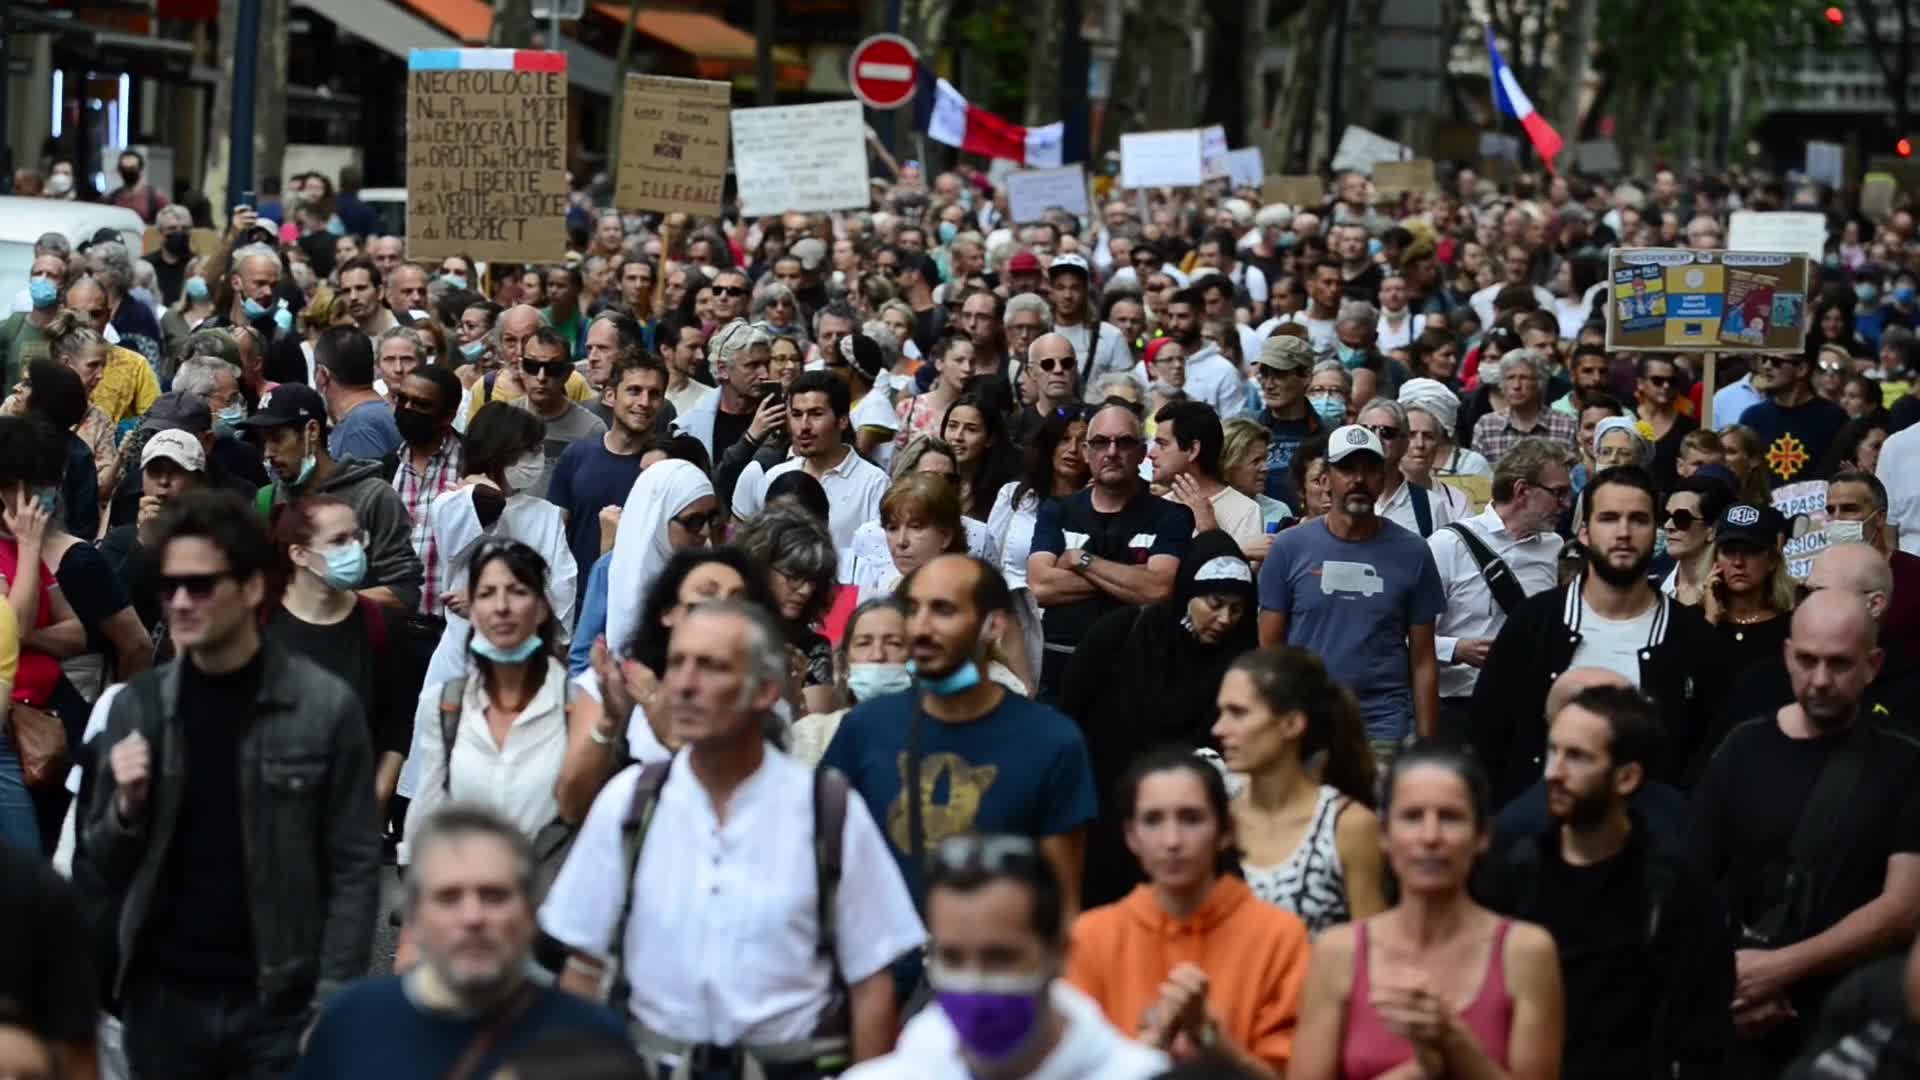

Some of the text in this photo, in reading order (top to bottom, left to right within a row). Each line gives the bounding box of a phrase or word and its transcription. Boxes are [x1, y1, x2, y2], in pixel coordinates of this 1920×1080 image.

[415, 71, 559, 95] NECROLOGIE
[521, 97, 566, 120] MORT
[433, 121, 557, 146] DEMOCRATIE
[459, 170, 541, 193] LIBERTE
[446, 216, 529, 241] RESPECT
[1731, 508, 1755, 523] DEUS
